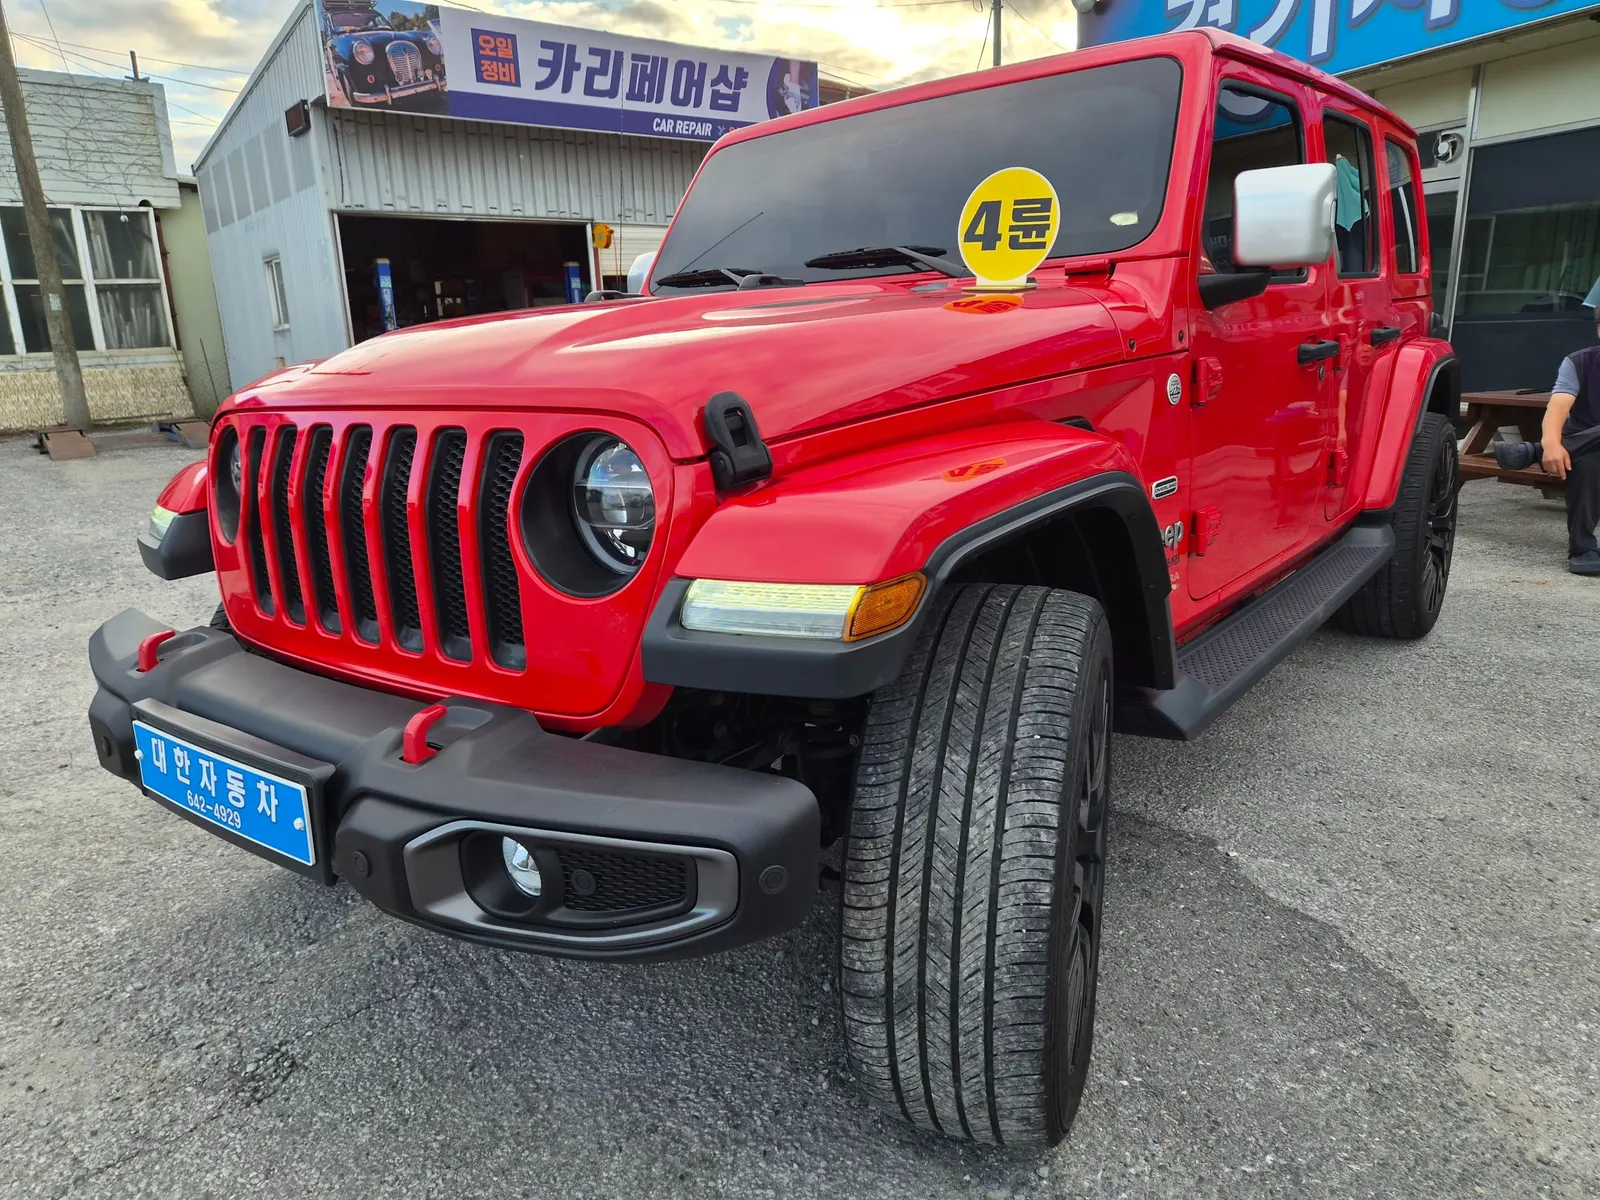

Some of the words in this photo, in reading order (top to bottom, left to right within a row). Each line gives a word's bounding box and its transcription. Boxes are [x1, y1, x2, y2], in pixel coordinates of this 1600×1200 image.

[478, 34, 514, 60] 오일
[480, 59, 517, 84] 정비
[535, 39, 749, 113] 카리페어샵
[652, 117, 675, 133] CAR
[675, 120, 713, 137] REPAIR
[963, 197, 1053, 251] 4륜
[186, 789, 242, 830] 642-4929
